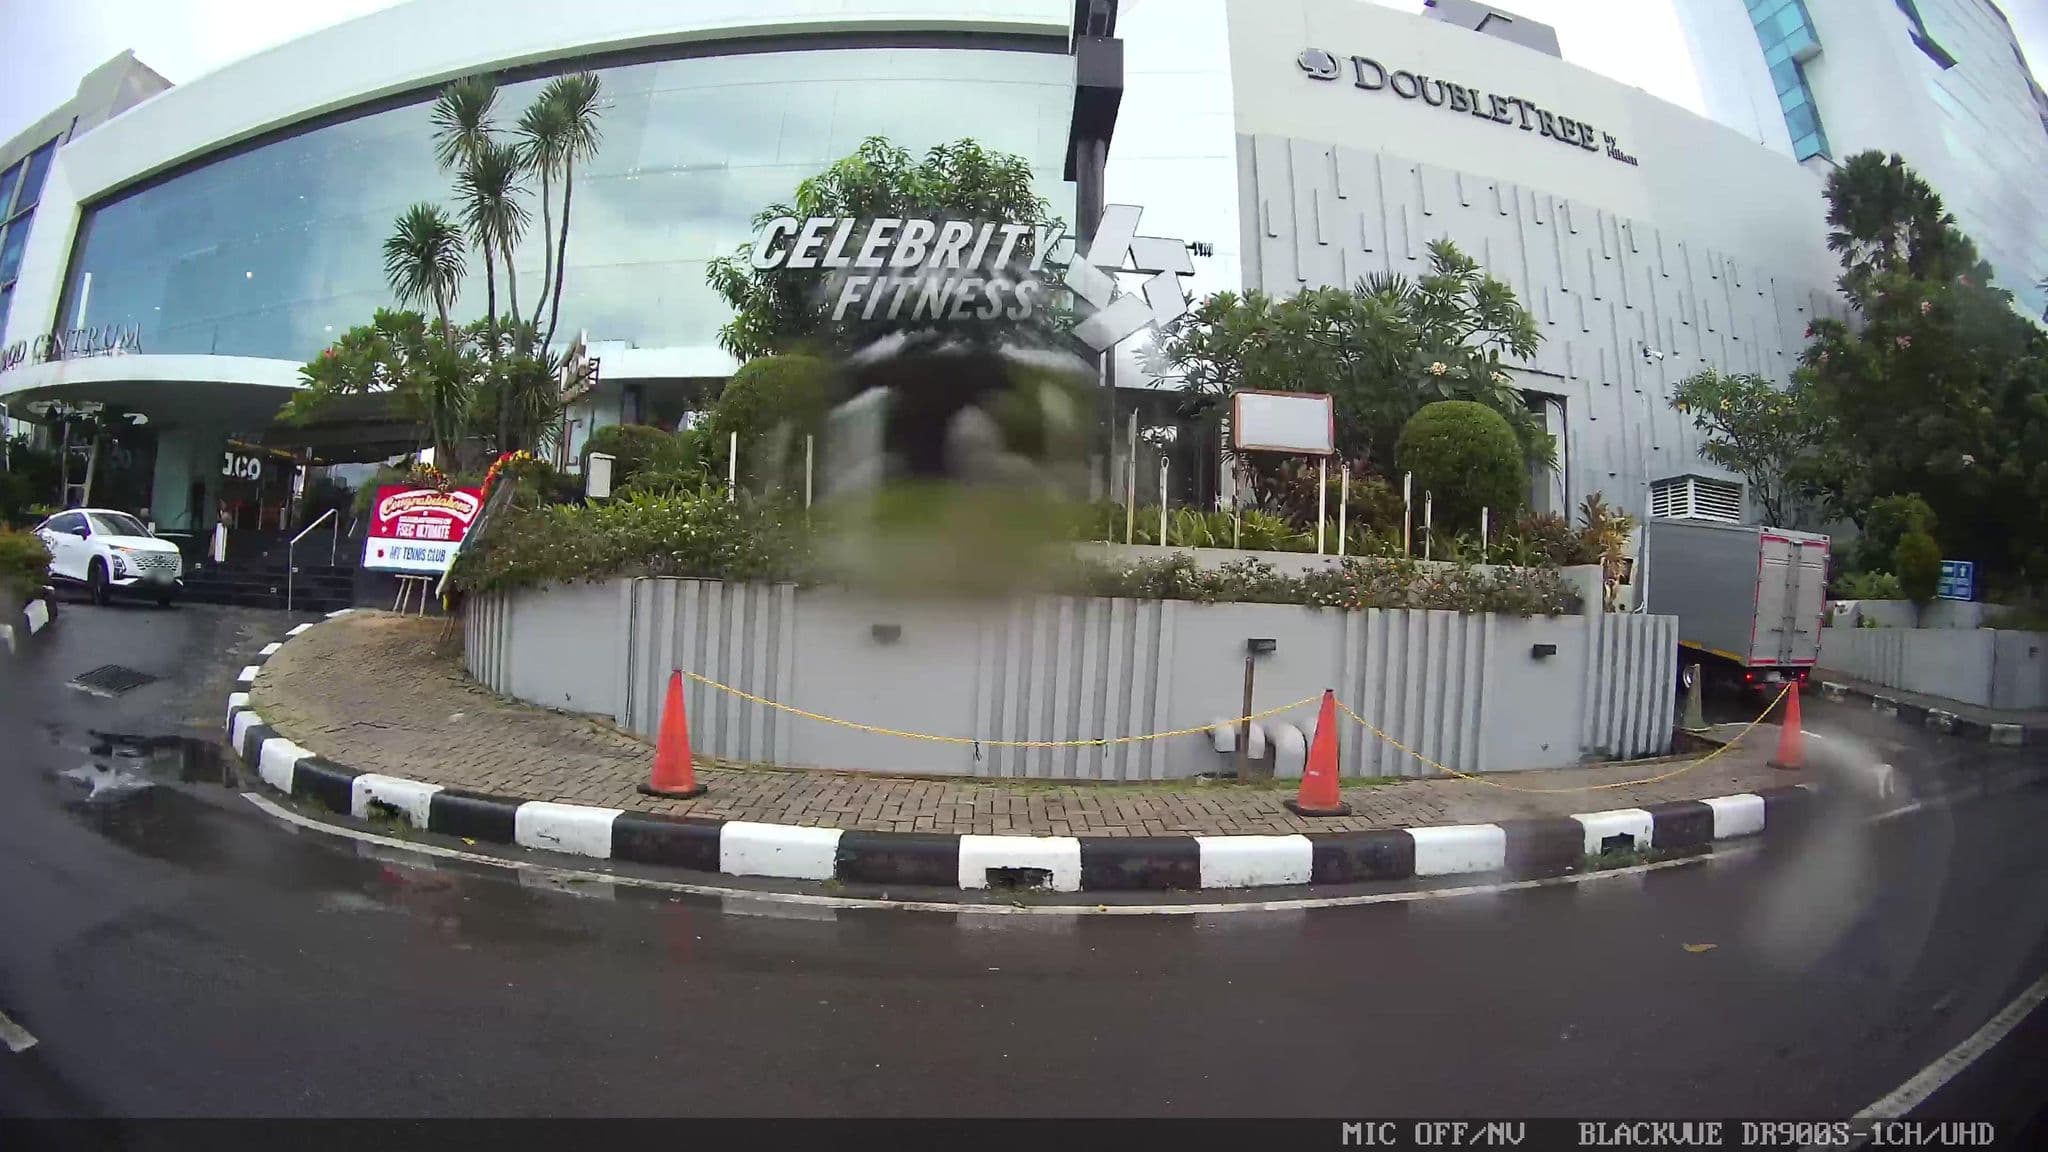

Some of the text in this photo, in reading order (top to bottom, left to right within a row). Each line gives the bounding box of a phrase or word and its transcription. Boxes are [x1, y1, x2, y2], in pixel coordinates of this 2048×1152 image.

[1603, 131, 1616, 151] by
[1607, 146, 1638, 166] Hilton
[751, 216, 1066, 272] CELEBRITY
[831, 273, 1040, 322] FITNESS
[222, 452, 261, 480] J.CO
[403, 546, 425, 561] TENNIS
[427, 548, 446, 562] CLUB
